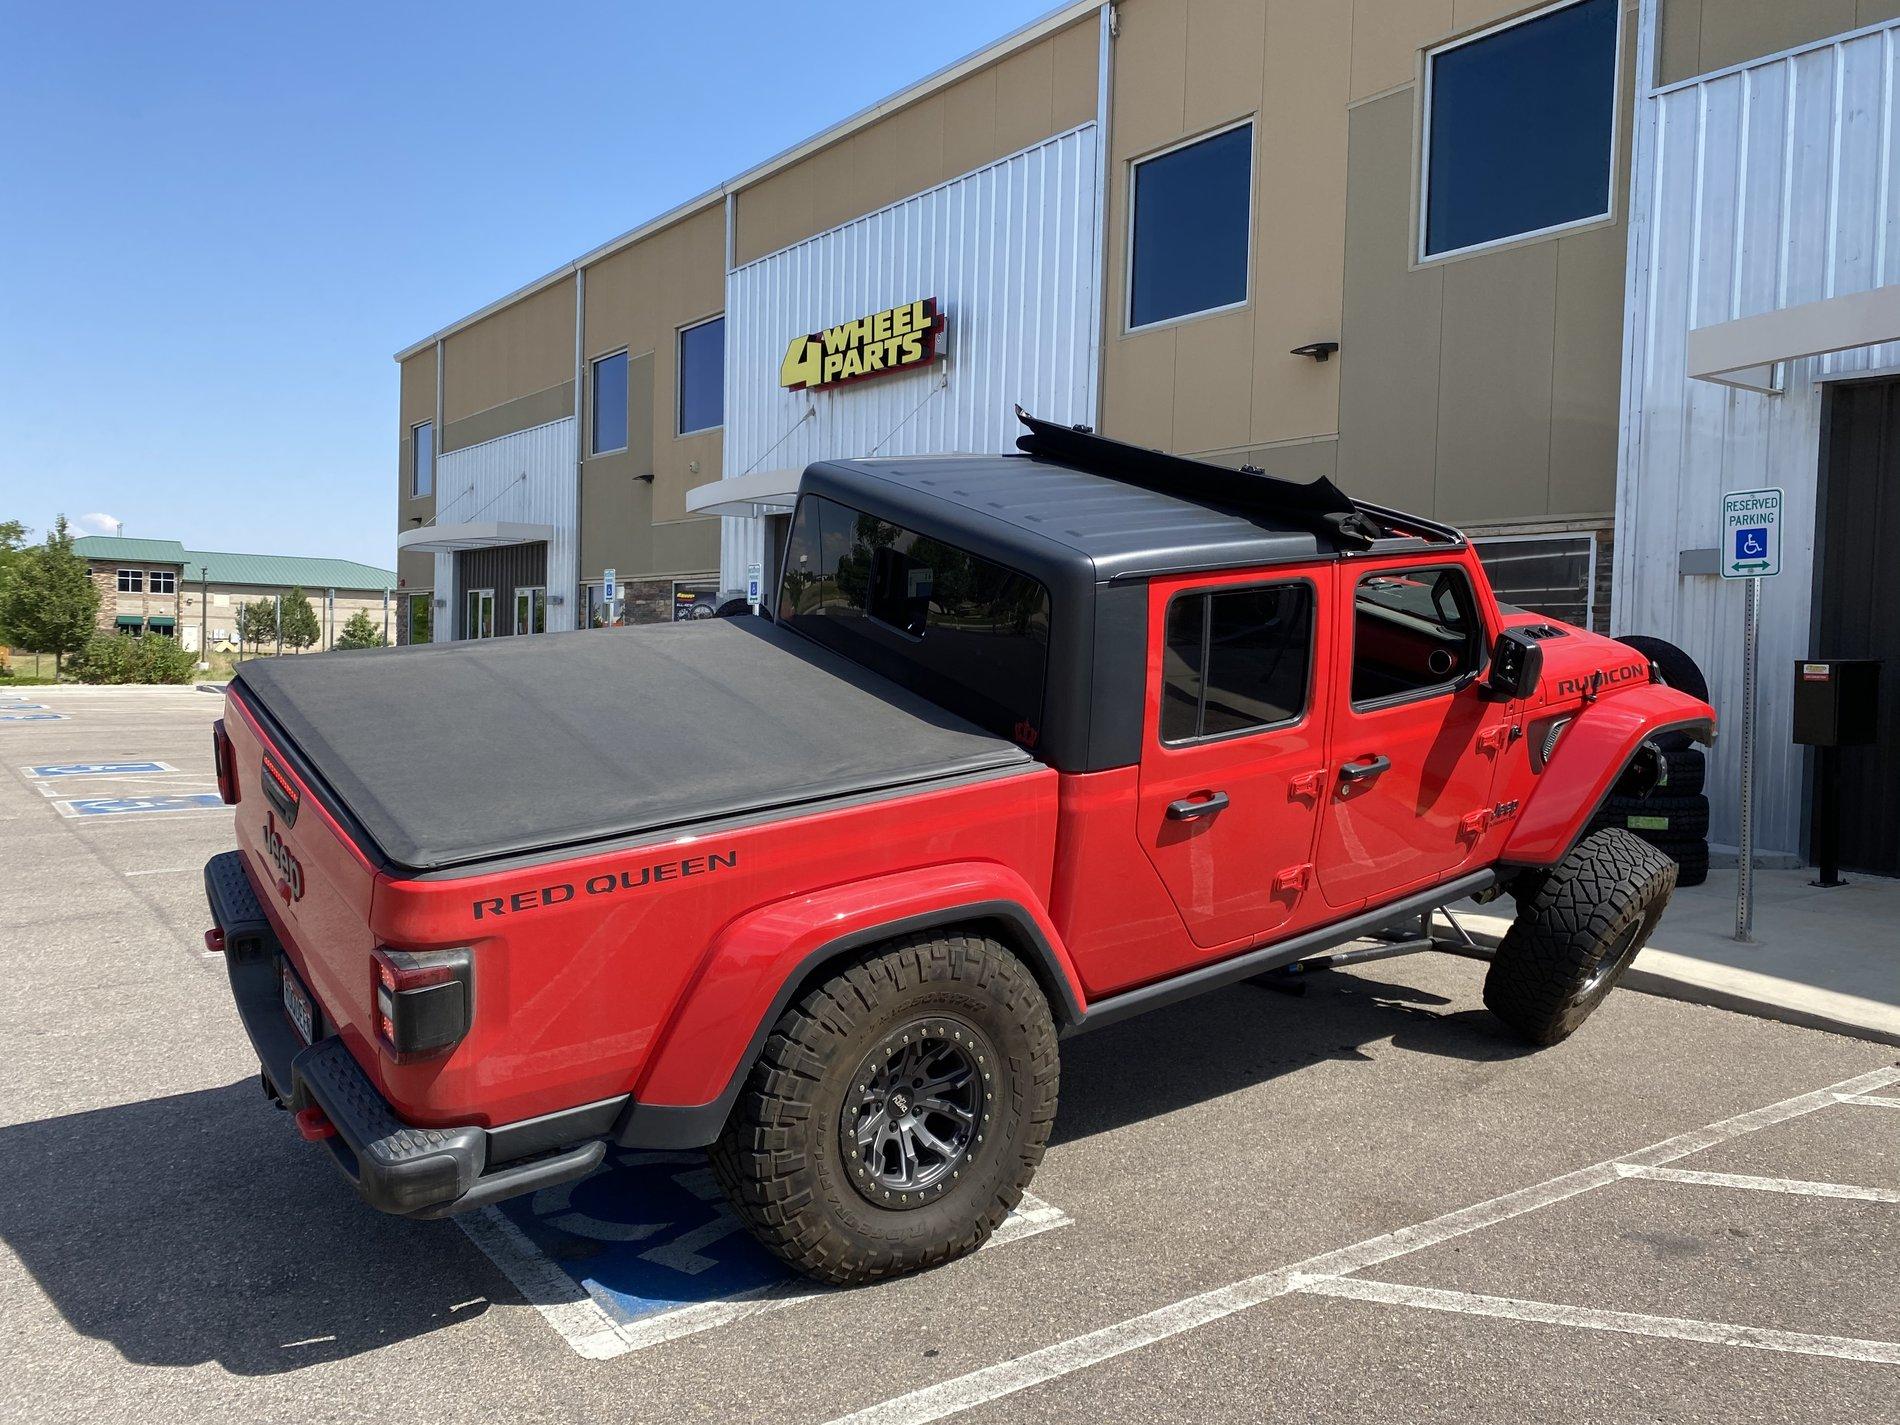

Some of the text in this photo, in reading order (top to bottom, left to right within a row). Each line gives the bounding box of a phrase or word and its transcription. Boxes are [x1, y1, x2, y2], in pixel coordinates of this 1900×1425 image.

[781, 300, 932, 388] 4 WHEEL
[824, 330, 922, 384] PARTS
[1726, 498, 1778, 512] RESERVED
[1729, 512, 1774, 526] PARKING
[473, 850, 737, 920] RED QUEEN
